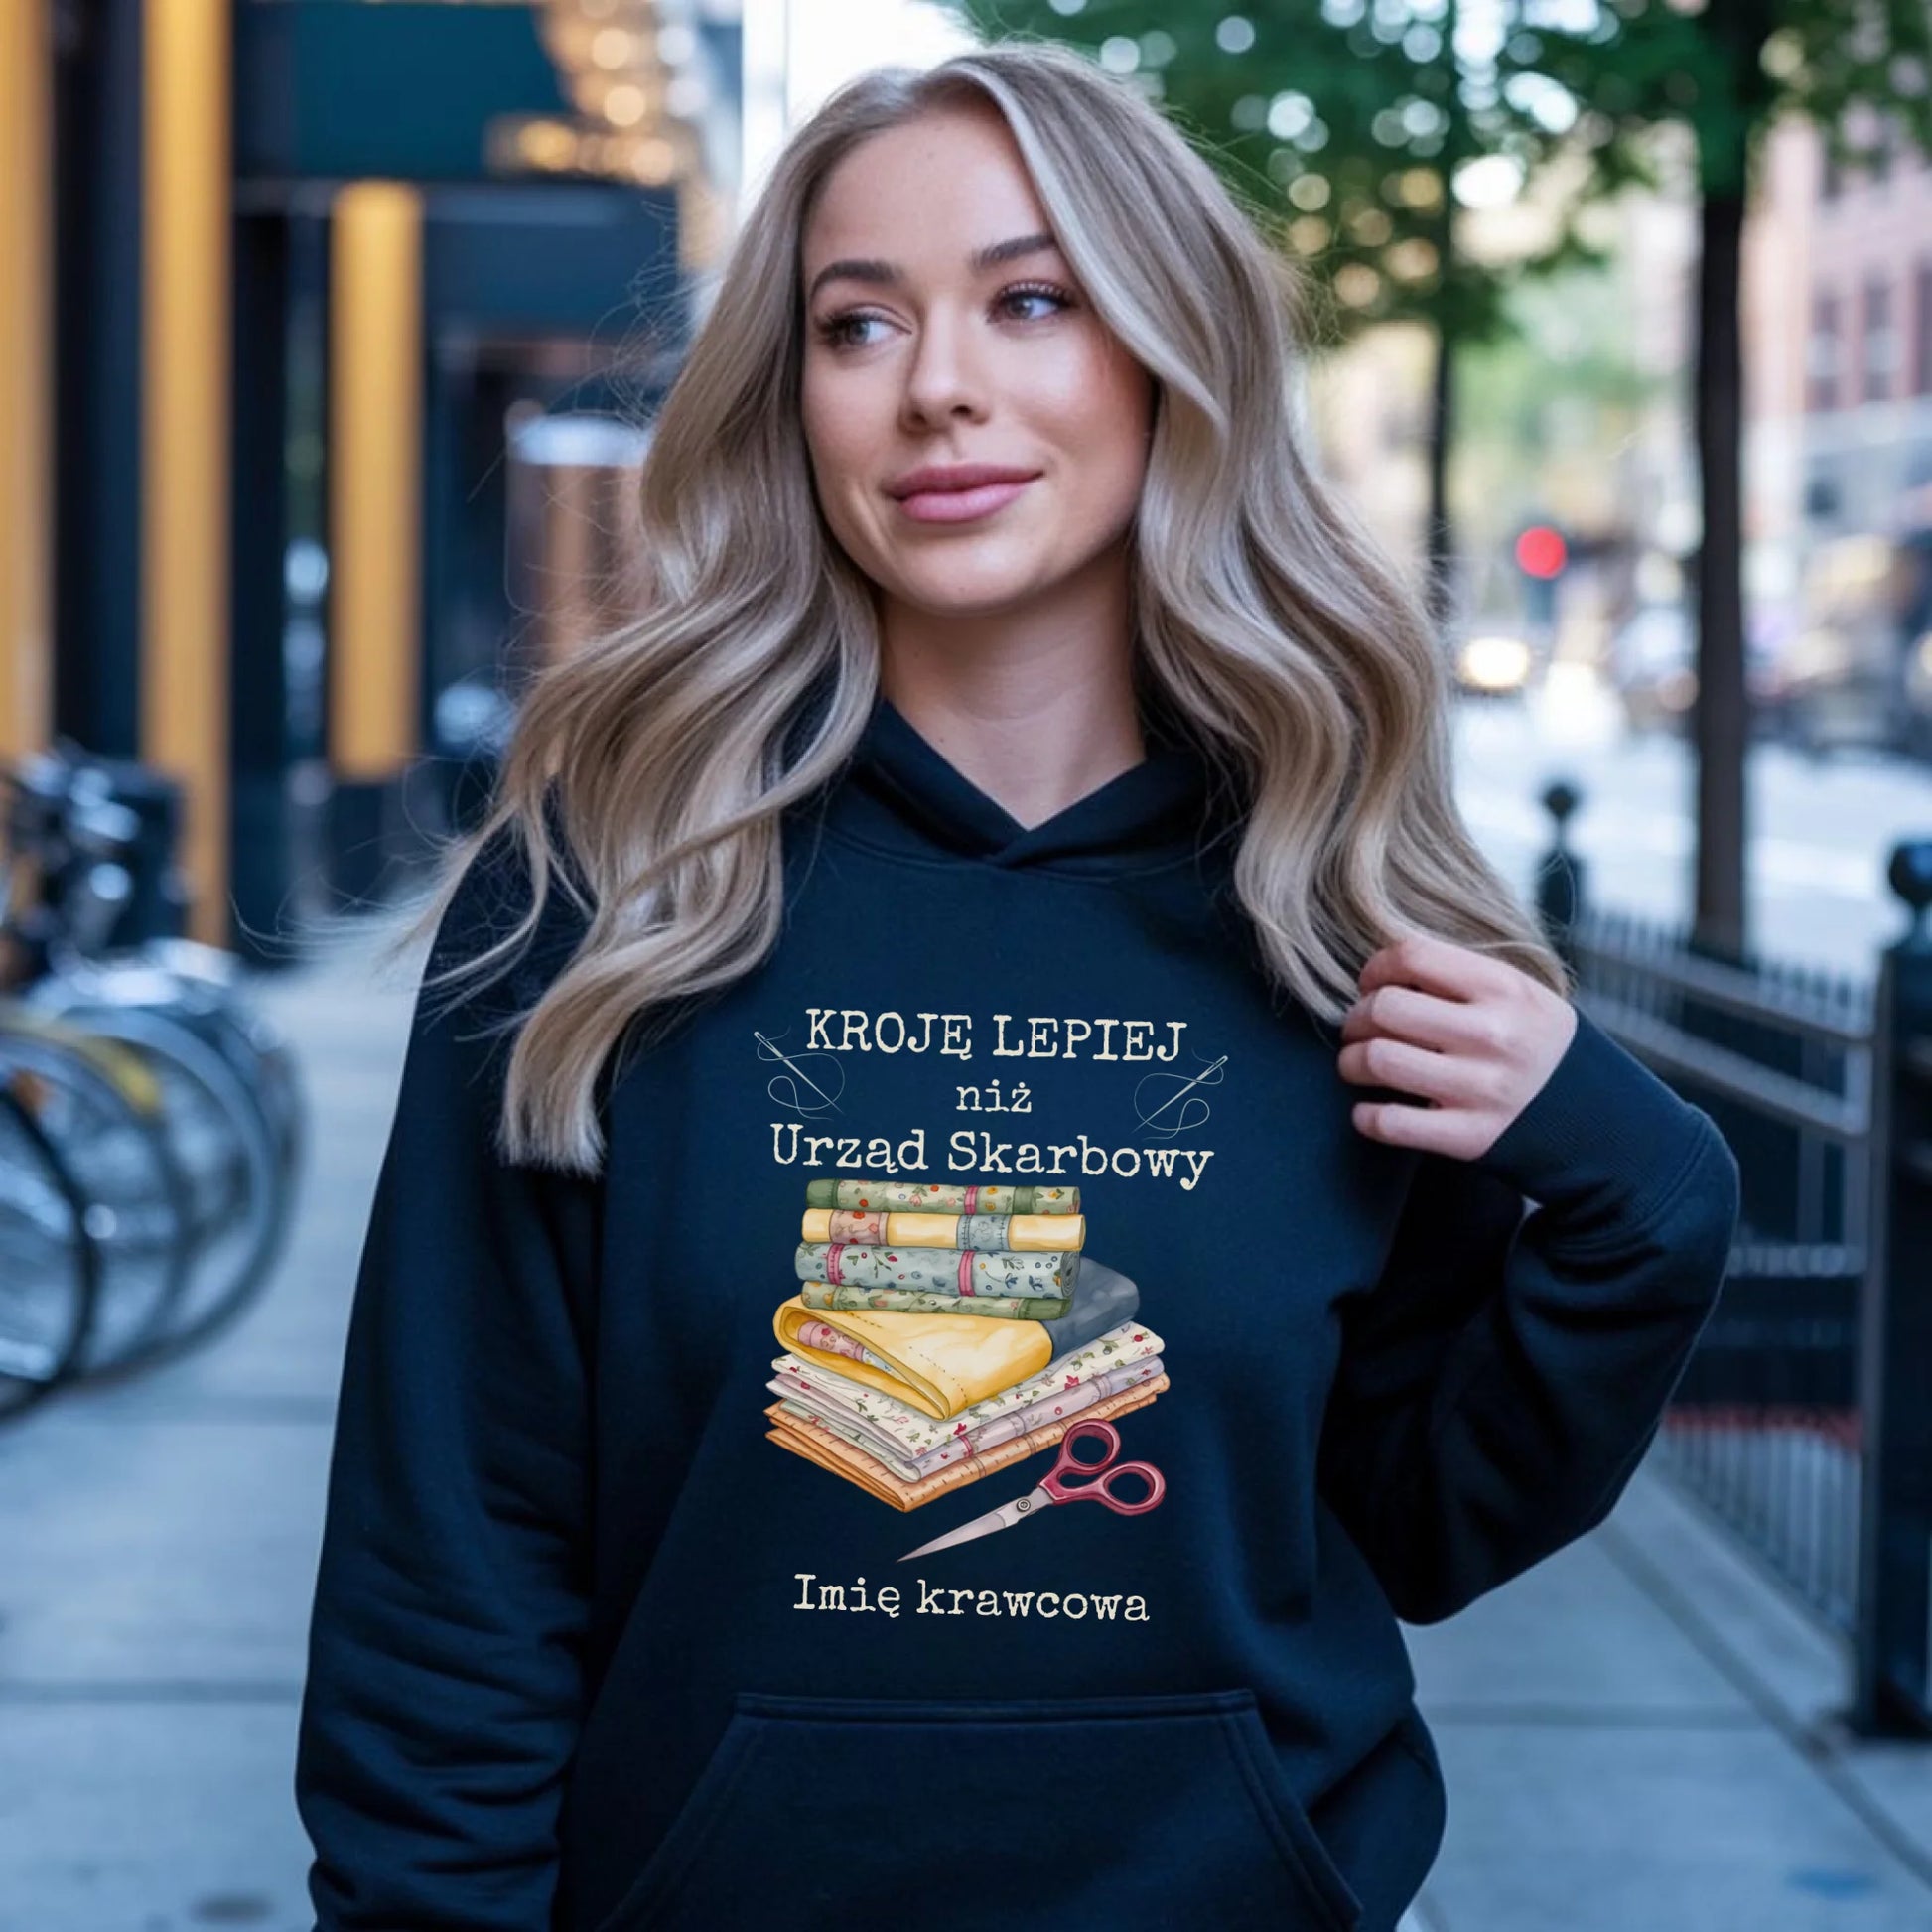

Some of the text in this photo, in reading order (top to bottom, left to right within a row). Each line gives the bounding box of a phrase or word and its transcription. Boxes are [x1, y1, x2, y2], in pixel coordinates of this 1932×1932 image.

[805, 1008, 1188, 1062] KROJĘ LEPIEJ
[955, 1078, 1033, 1114] niż
[769, 1123, 1215, 1191] Urząd Skarbowy
[793, 1573, 1151, 1622] Imię krawcowa
